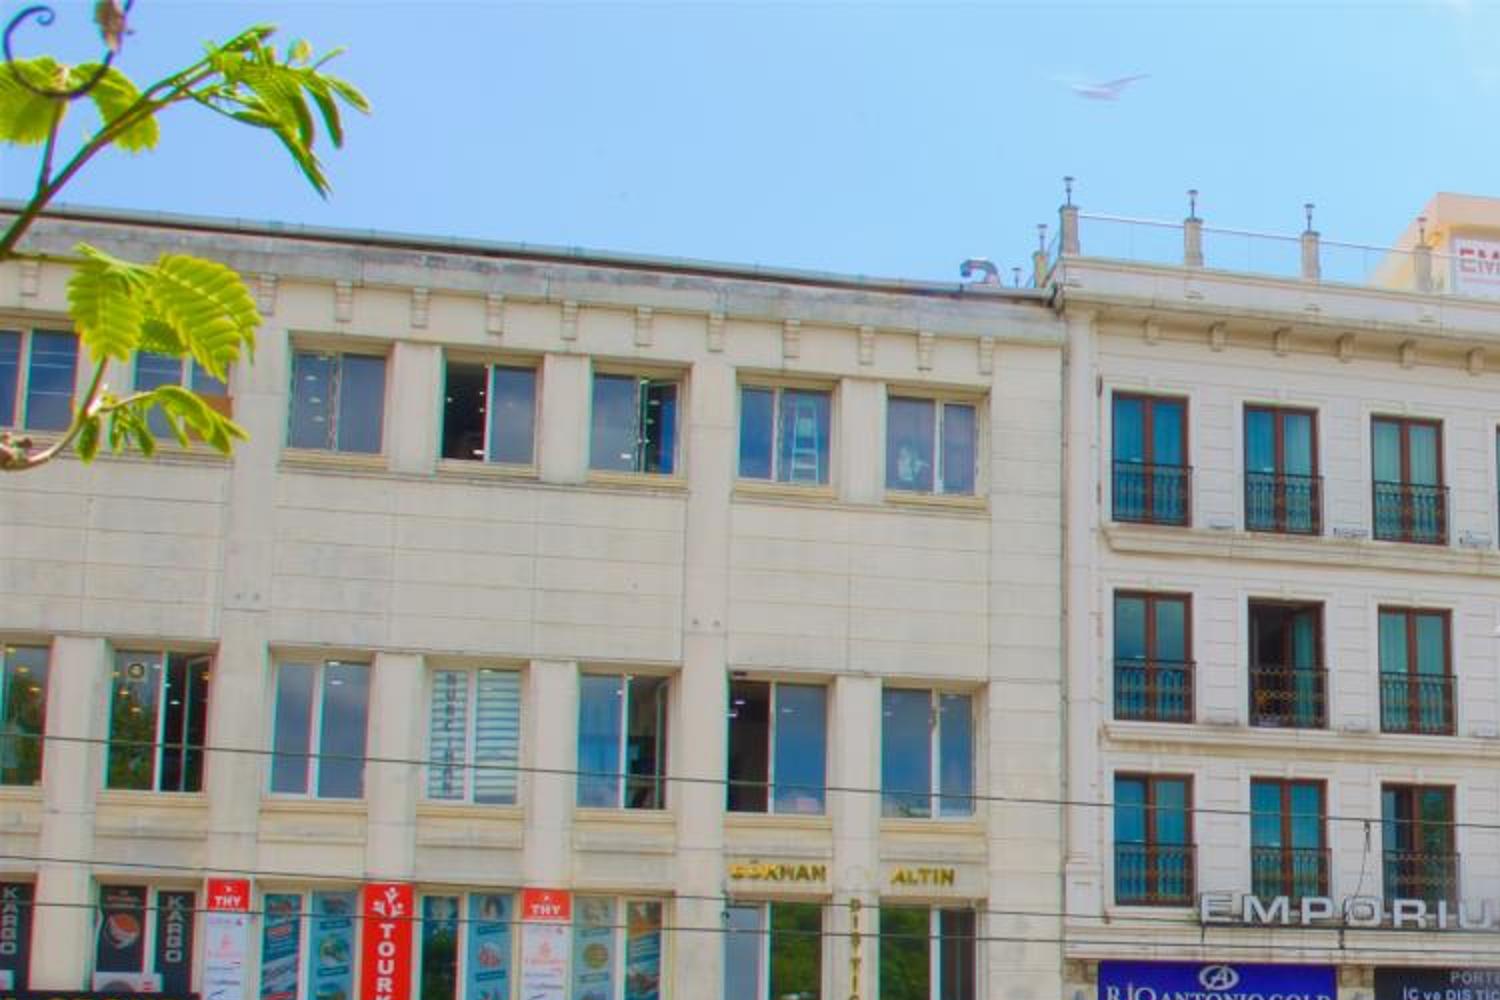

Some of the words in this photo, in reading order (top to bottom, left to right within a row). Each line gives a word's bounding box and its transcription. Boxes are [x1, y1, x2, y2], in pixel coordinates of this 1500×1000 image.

[890, 867, 956, 886] ALTIN
[214, 895, 242, 906] THY
[531, 904, 561, 915] THY
[164, 896, 184, 963] KARGO
